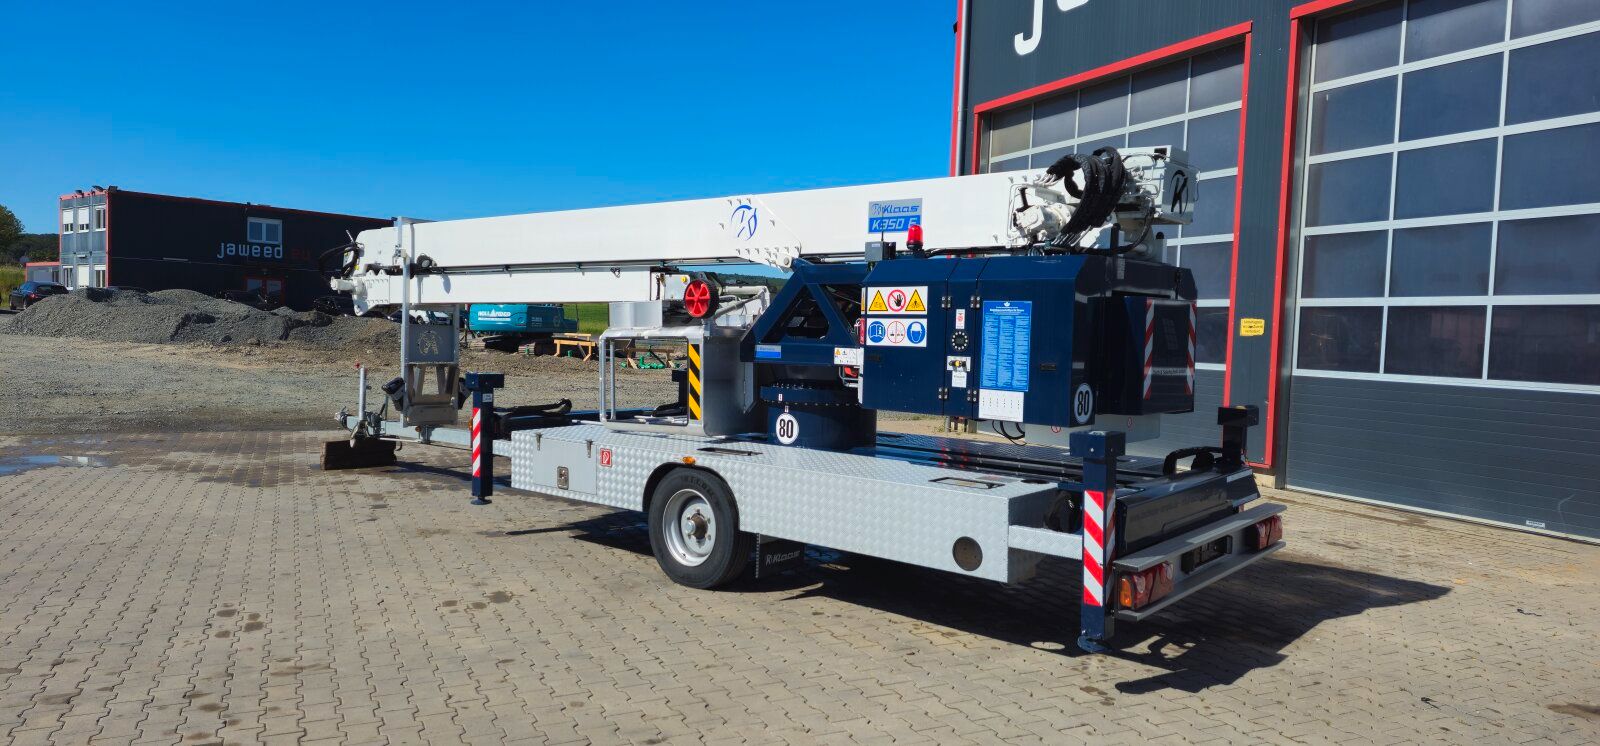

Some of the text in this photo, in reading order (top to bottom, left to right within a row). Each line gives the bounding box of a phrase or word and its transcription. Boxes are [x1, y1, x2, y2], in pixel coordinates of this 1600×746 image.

[882, 204, 920, 214] Klaas
[216, 242, 283, 259] jaweed
[1077, 390, 1090, 416] 80
[779, 418, 794, 438] 80
